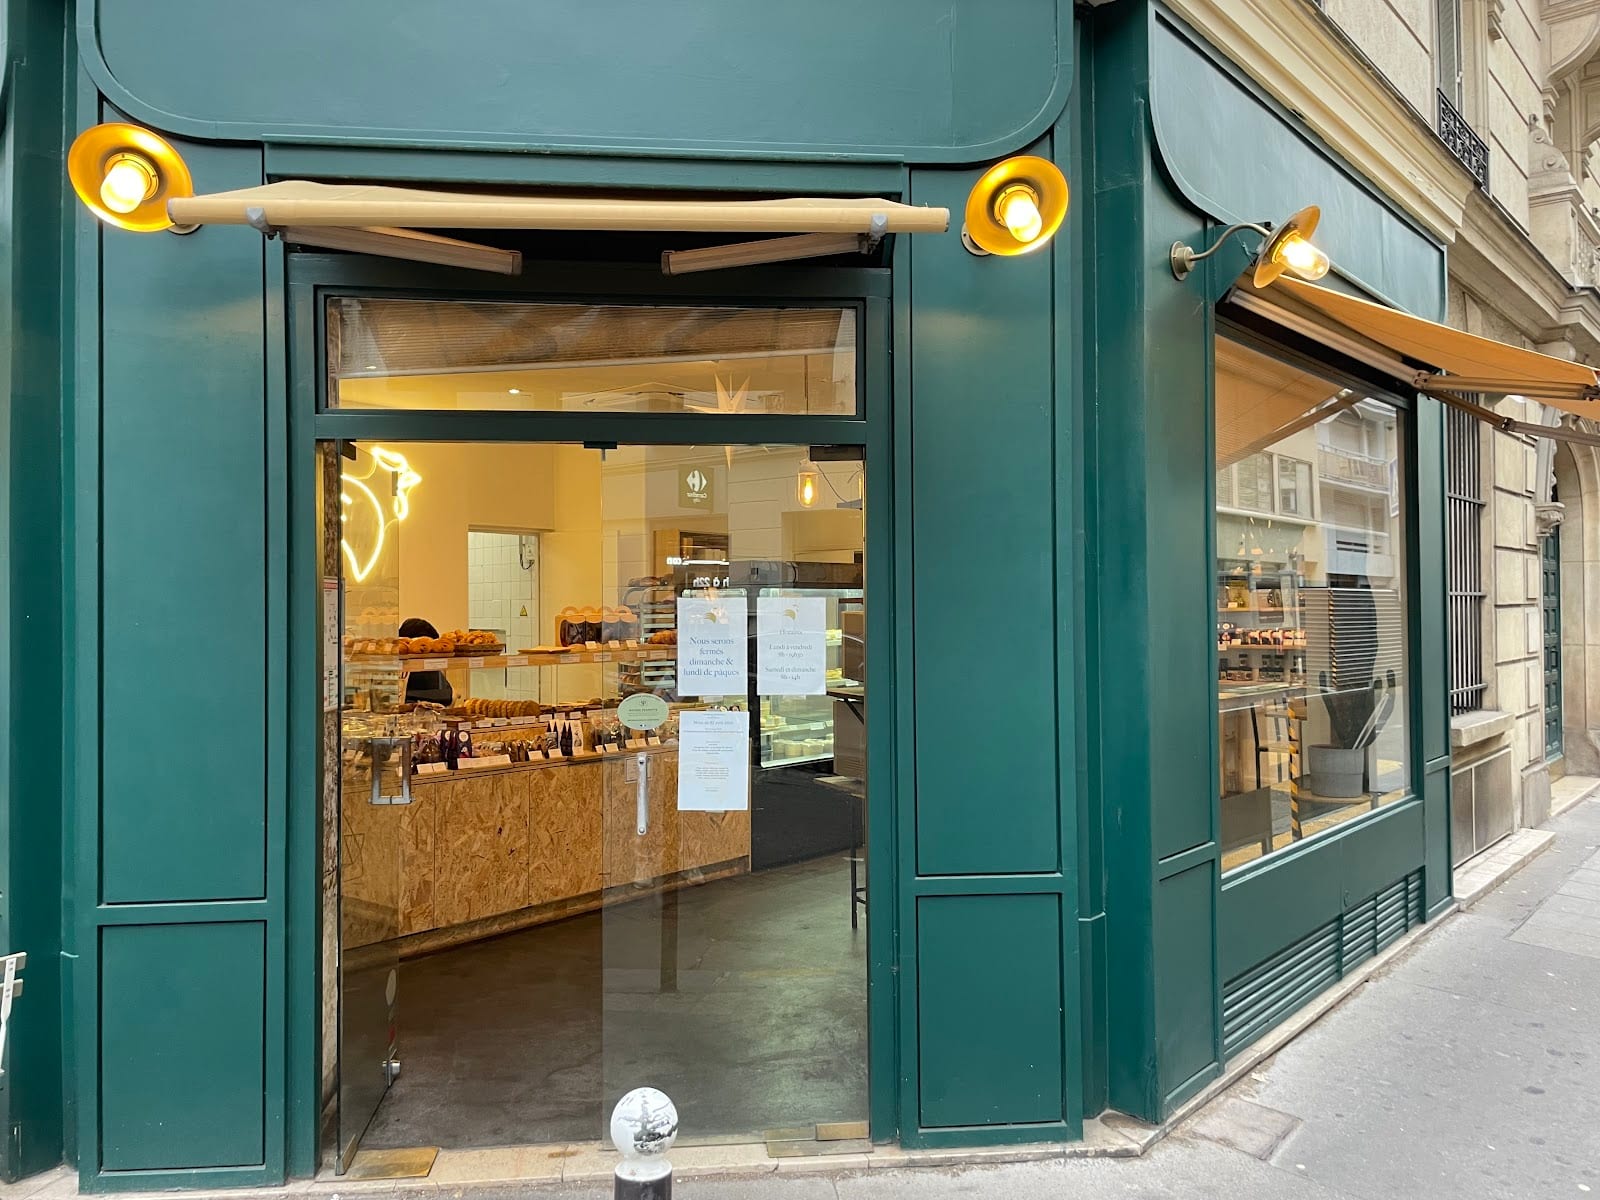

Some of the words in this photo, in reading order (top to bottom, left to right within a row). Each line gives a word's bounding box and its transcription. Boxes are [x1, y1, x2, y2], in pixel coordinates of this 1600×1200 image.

[689, 637, 710, 645] Nous
[699, 647, 724, 655] fermés
[683, 668, 703, 676] lundi
[703, 668, 712, 676] de
